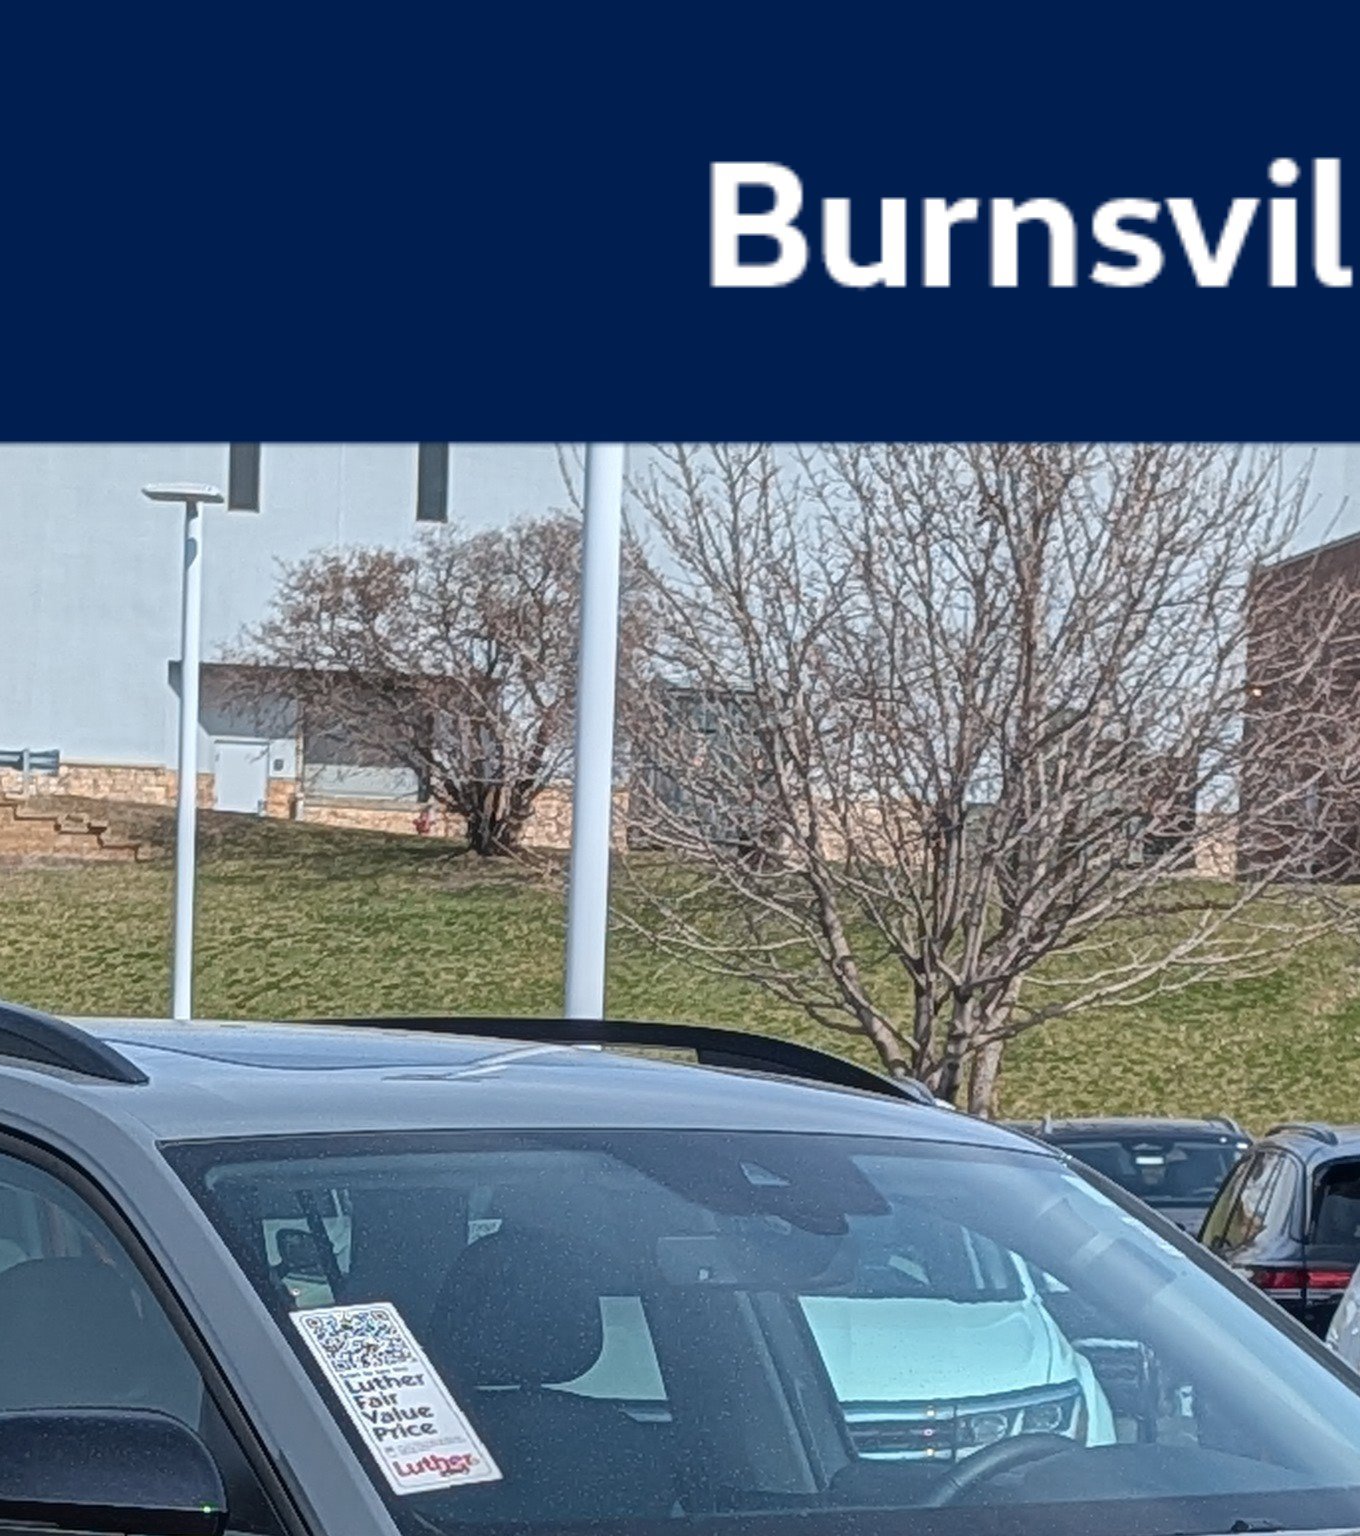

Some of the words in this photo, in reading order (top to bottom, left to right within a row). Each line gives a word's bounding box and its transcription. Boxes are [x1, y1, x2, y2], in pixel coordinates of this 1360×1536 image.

[344, 1373, 425, 1394] Luther
[353, 1391, 398, 1410] Fair
[362, 1406, 434, 1424] Value
[372, 1422, 437, 1442] Price
[392, 1453, 474, 1477] Luther
